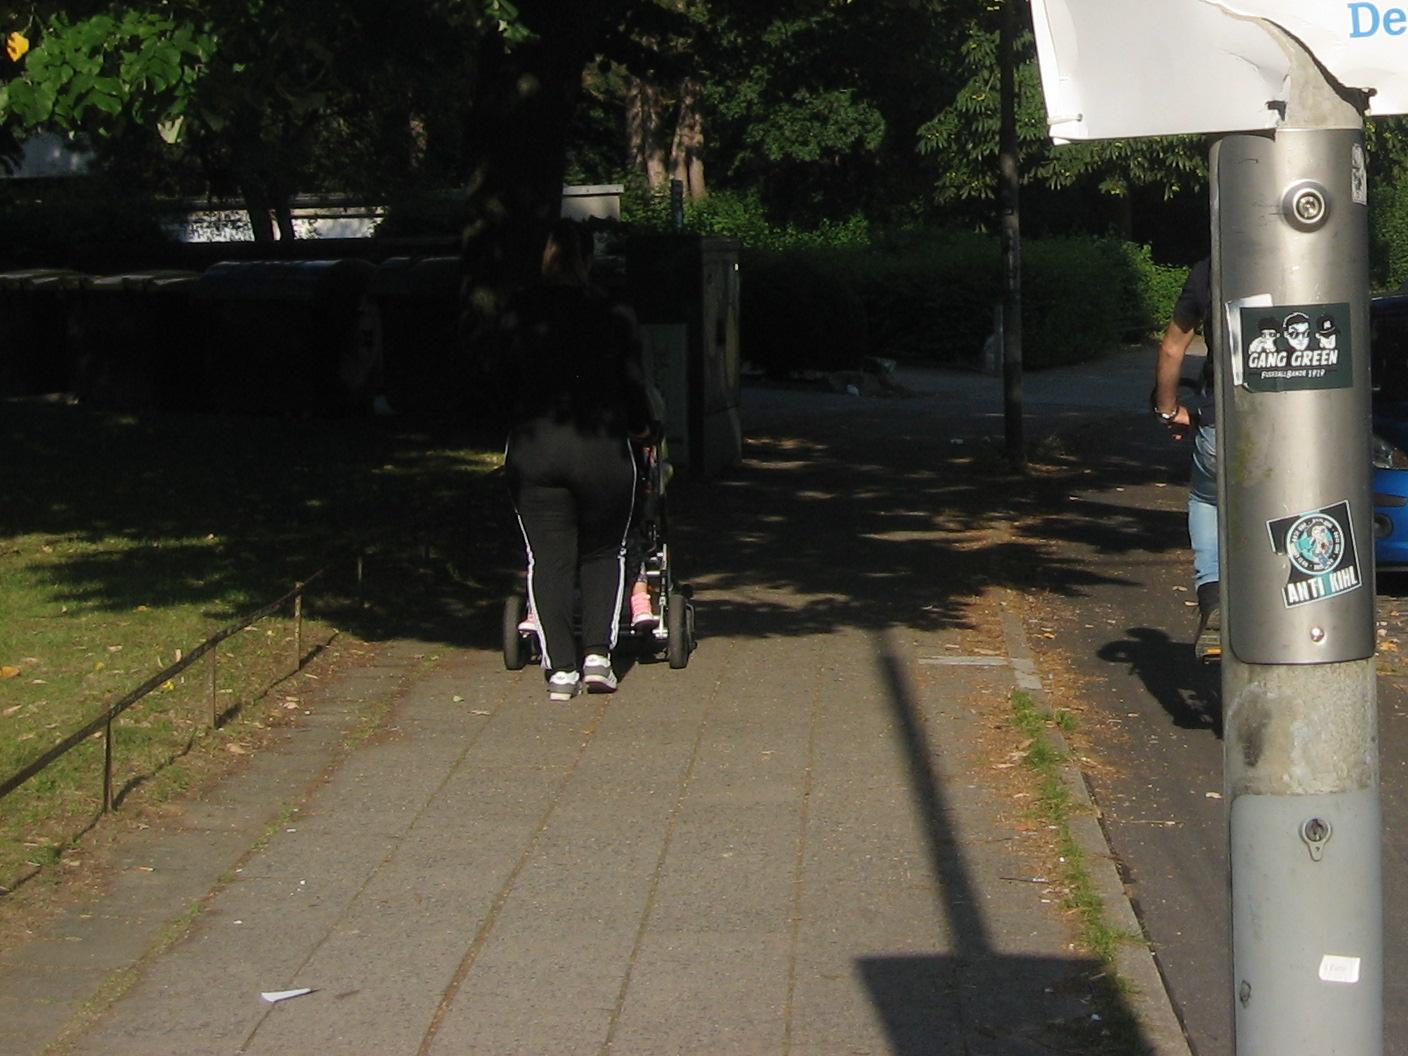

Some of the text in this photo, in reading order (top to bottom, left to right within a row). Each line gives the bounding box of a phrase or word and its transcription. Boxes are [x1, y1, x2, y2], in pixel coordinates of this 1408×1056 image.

[1248, 349, 1338, 368] GANG GREEN
[1287, 576, 1326, 604] ANTI
